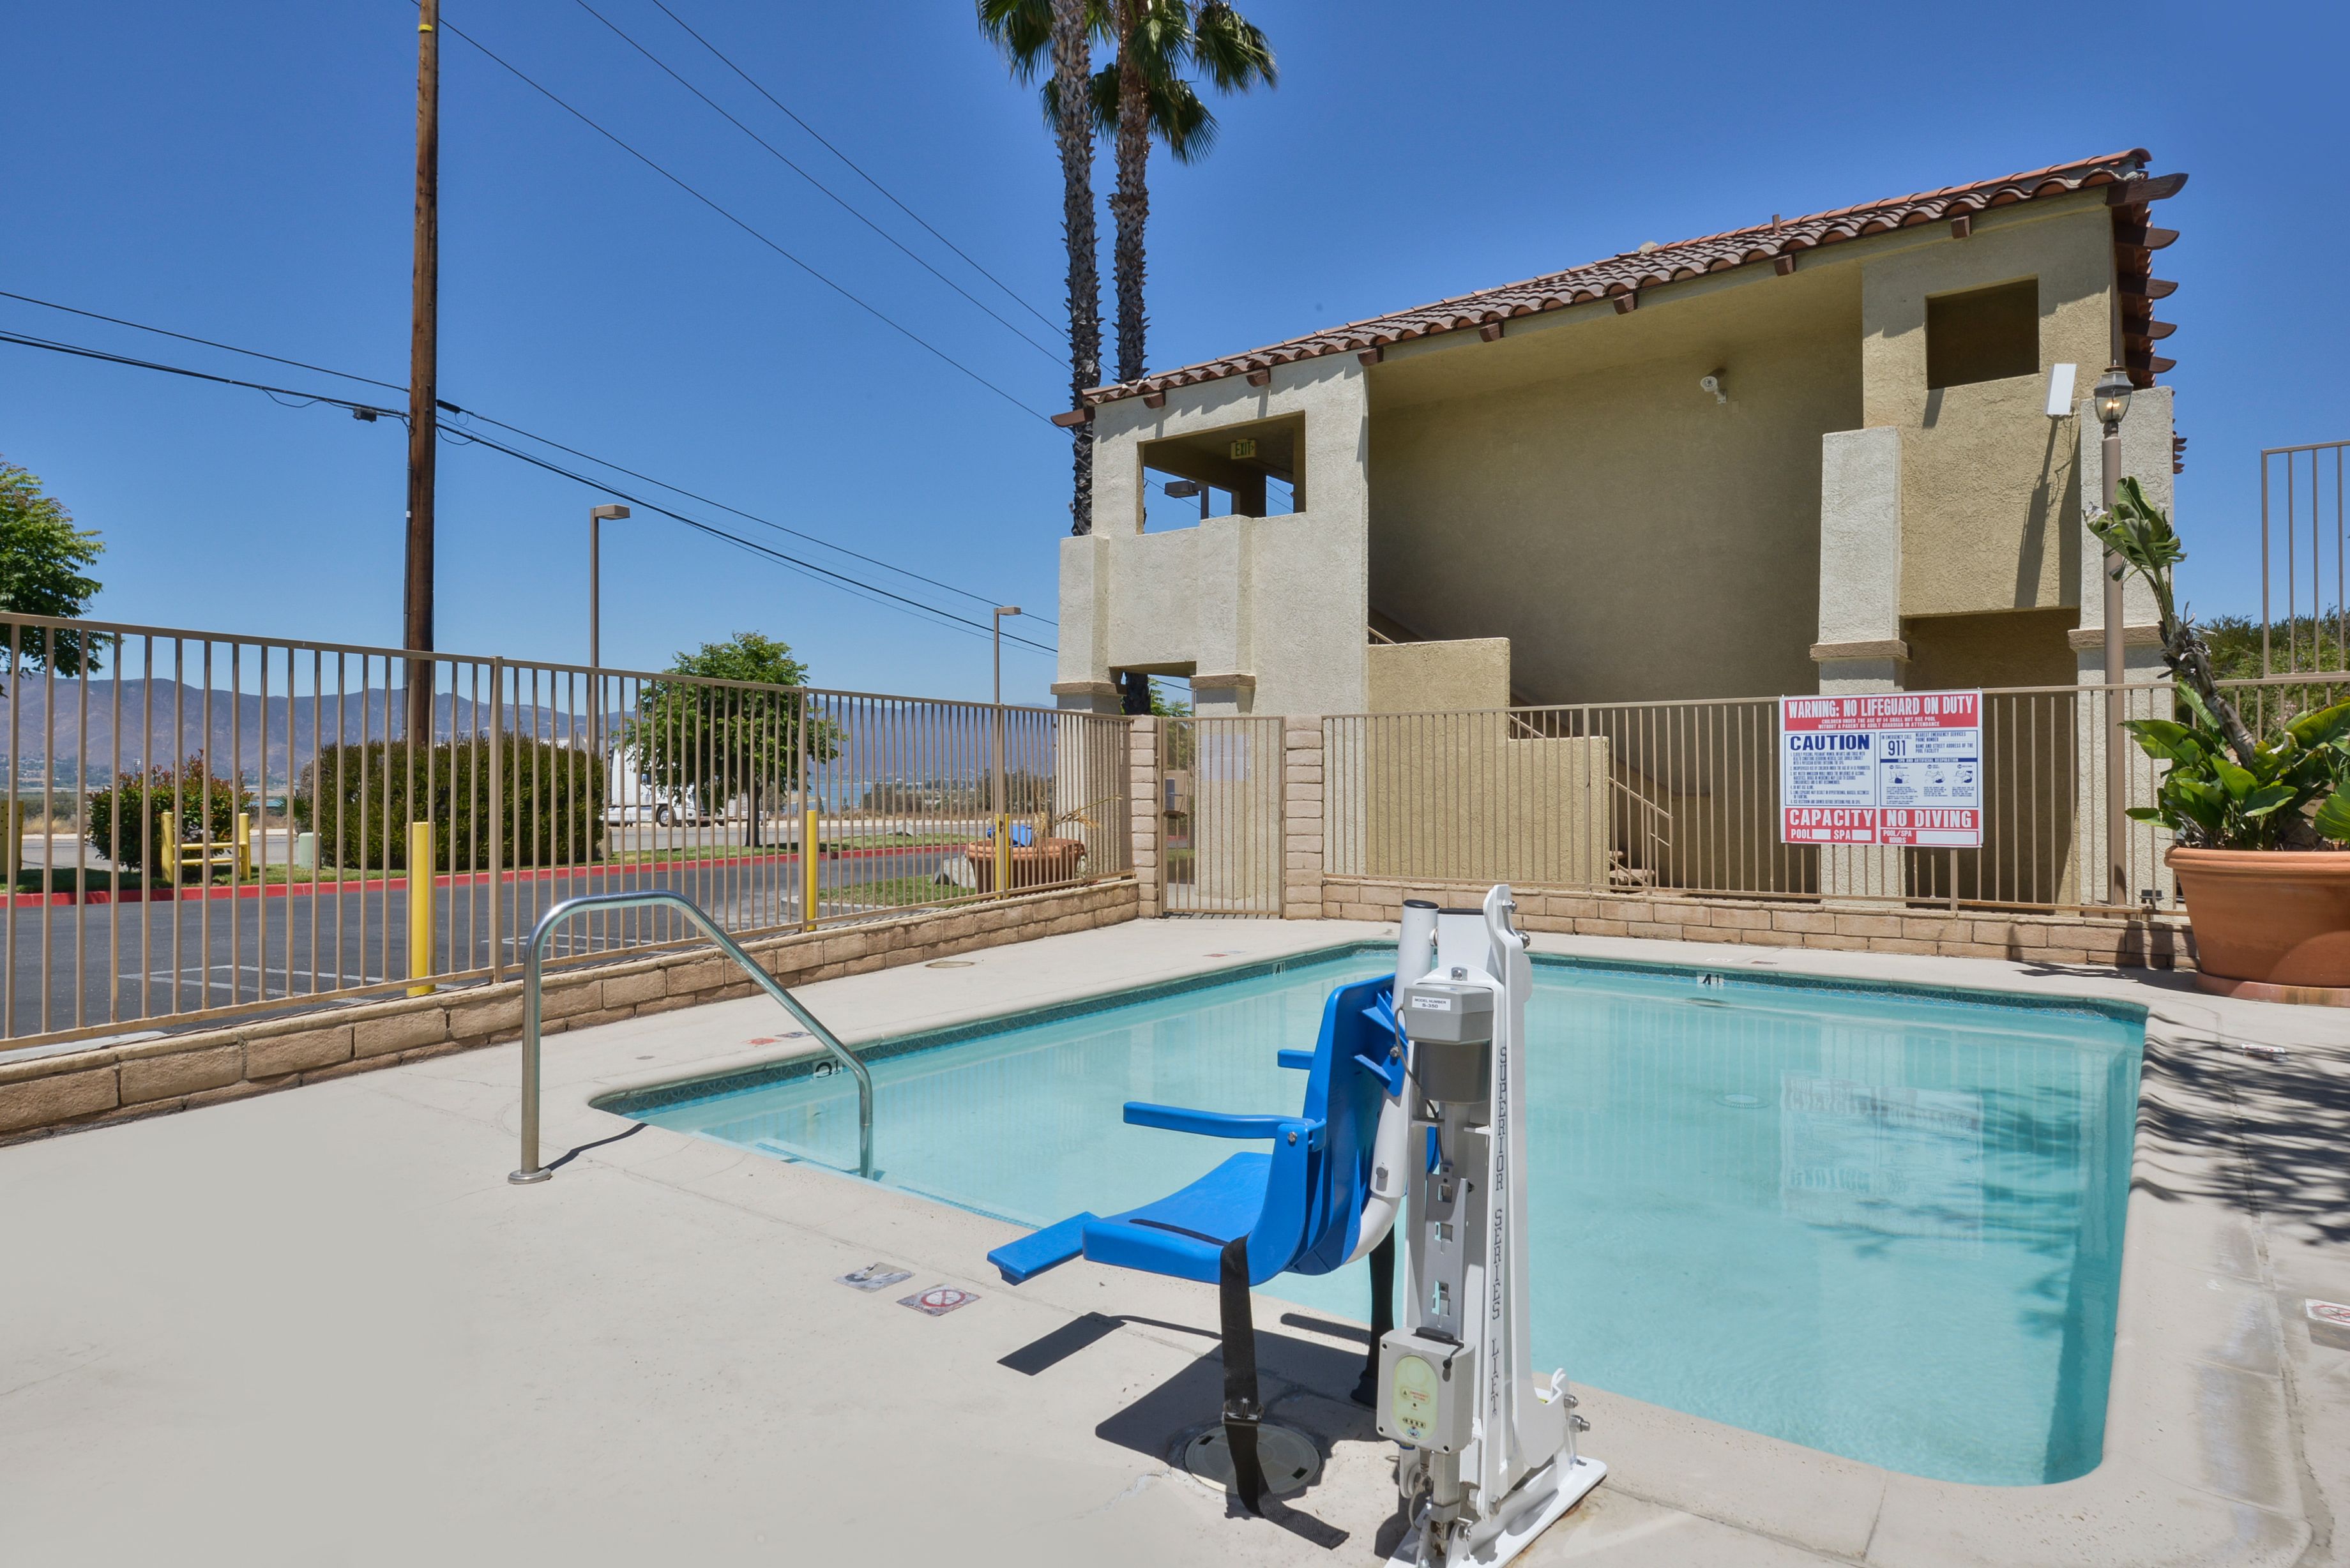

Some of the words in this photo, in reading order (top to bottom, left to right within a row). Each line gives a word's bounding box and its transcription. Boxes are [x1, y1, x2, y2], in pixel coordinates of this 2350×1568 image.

[1236, 441, 1251, 456] EXIT
[1788, 700, 1839, 718] WARNING:
[1843, 699, 1857, 717] NO
[1861, 697, 1920, 716] LIFEGUARD
[1924, 696, 1939, 715] ON
[1943, 695, 1973, 714] DUTY
[1790, 735, 1870, 751] CAUTION
[1888, 740, 1906, 756] 911
[1790, 809, 1874, 827] CAPACITY
[1886, 810, 1907, 827] NO
[1914, 810, 1972, 828] DIVING
[1791, 829, 1812, 839] POOL
[1833, 829, 1851, 840] SPA
[1495, 1046, 1507, 1191] SUPERIOR
[1492, 1209, 1503, 1320] SERIES
[1490, 1338, 1499, 1412] LIFT
